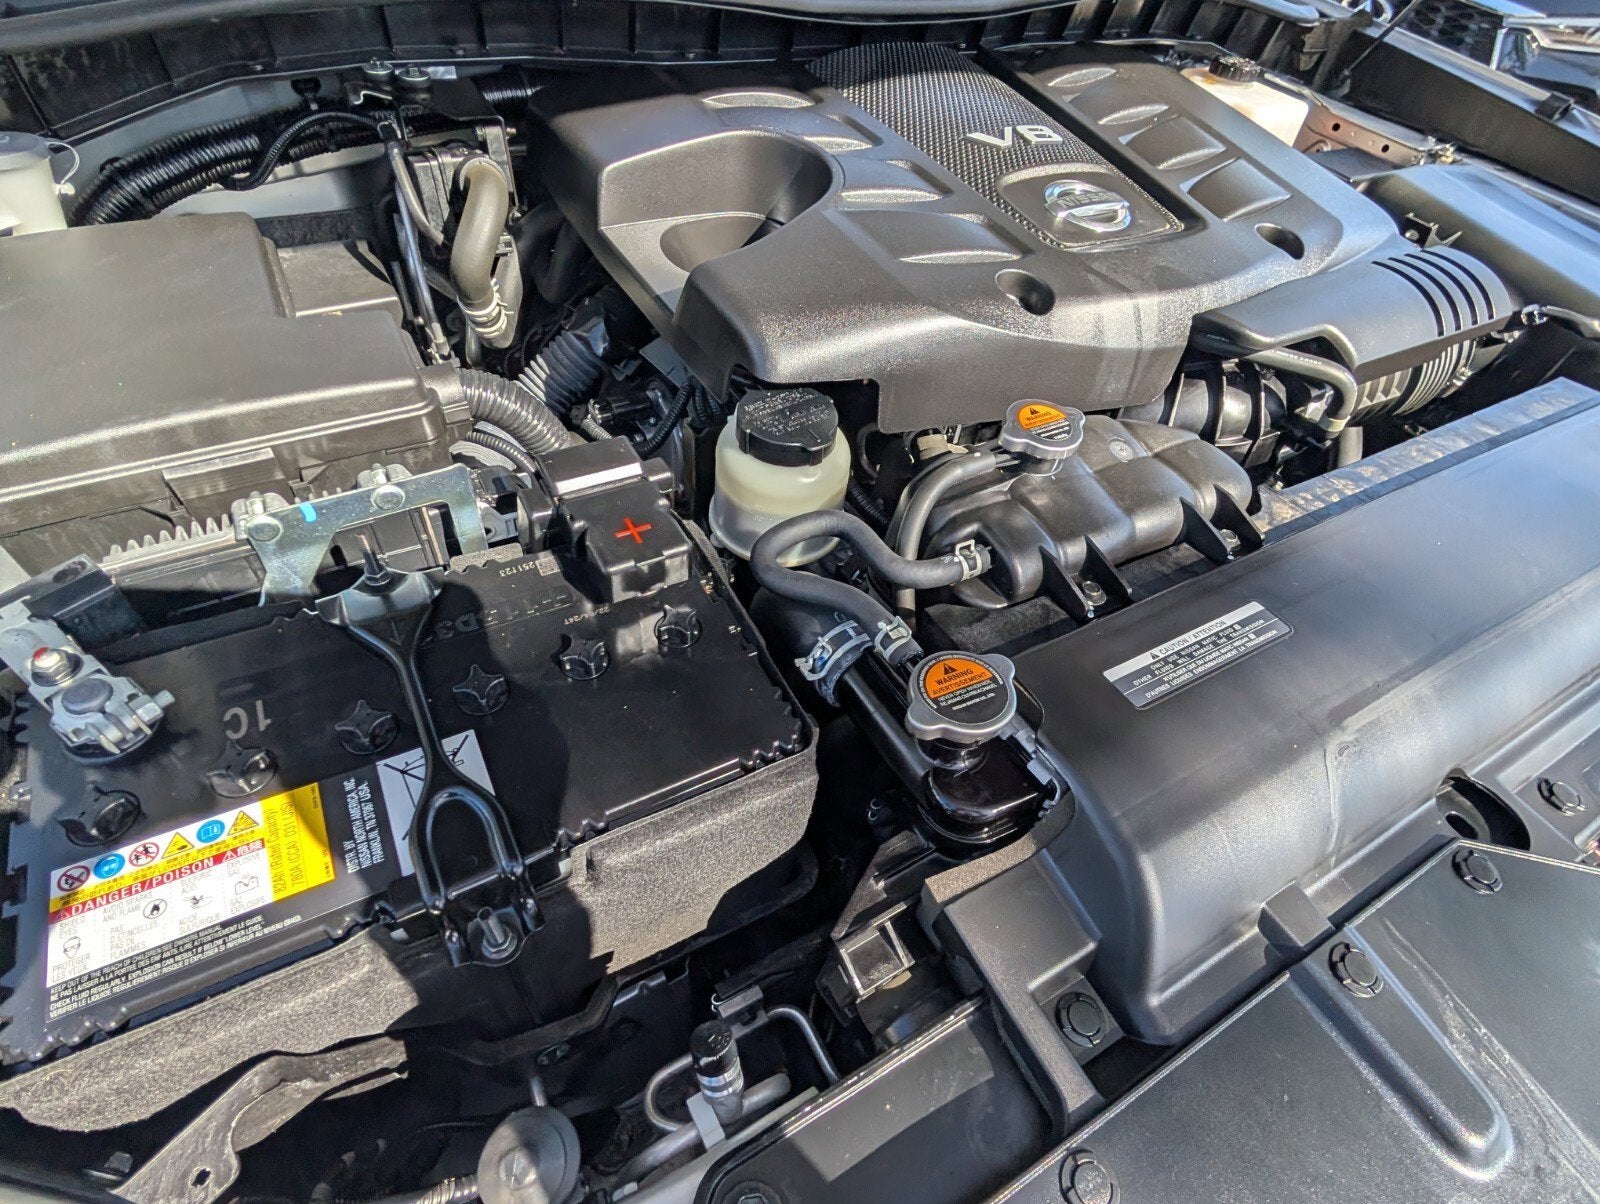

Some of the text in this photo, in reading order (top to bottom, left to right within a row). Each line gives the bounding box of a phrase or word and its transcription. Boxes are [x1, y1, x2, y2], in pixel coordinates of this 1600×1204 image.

[967, 124, 1063, 149] V8
[1158, 637, 1189, 654] CAUTION
[1191, 619, 1227, 639] ATTENTION
[935, 668, 974, 686] WARNING
[1132, 673, 1153, 686] OTHER
[222, 699, 272, 740] 1C
[282, 821, 296, 836] D31
[285, 839, 301, 863] (CCA)
[71, 855, 213, 916] DANGER/POISON
[271, 870, 287, 893] 82Ah
[289, 863, 304, 886] 780A
[59, 915, 84, 931] SHIELD
